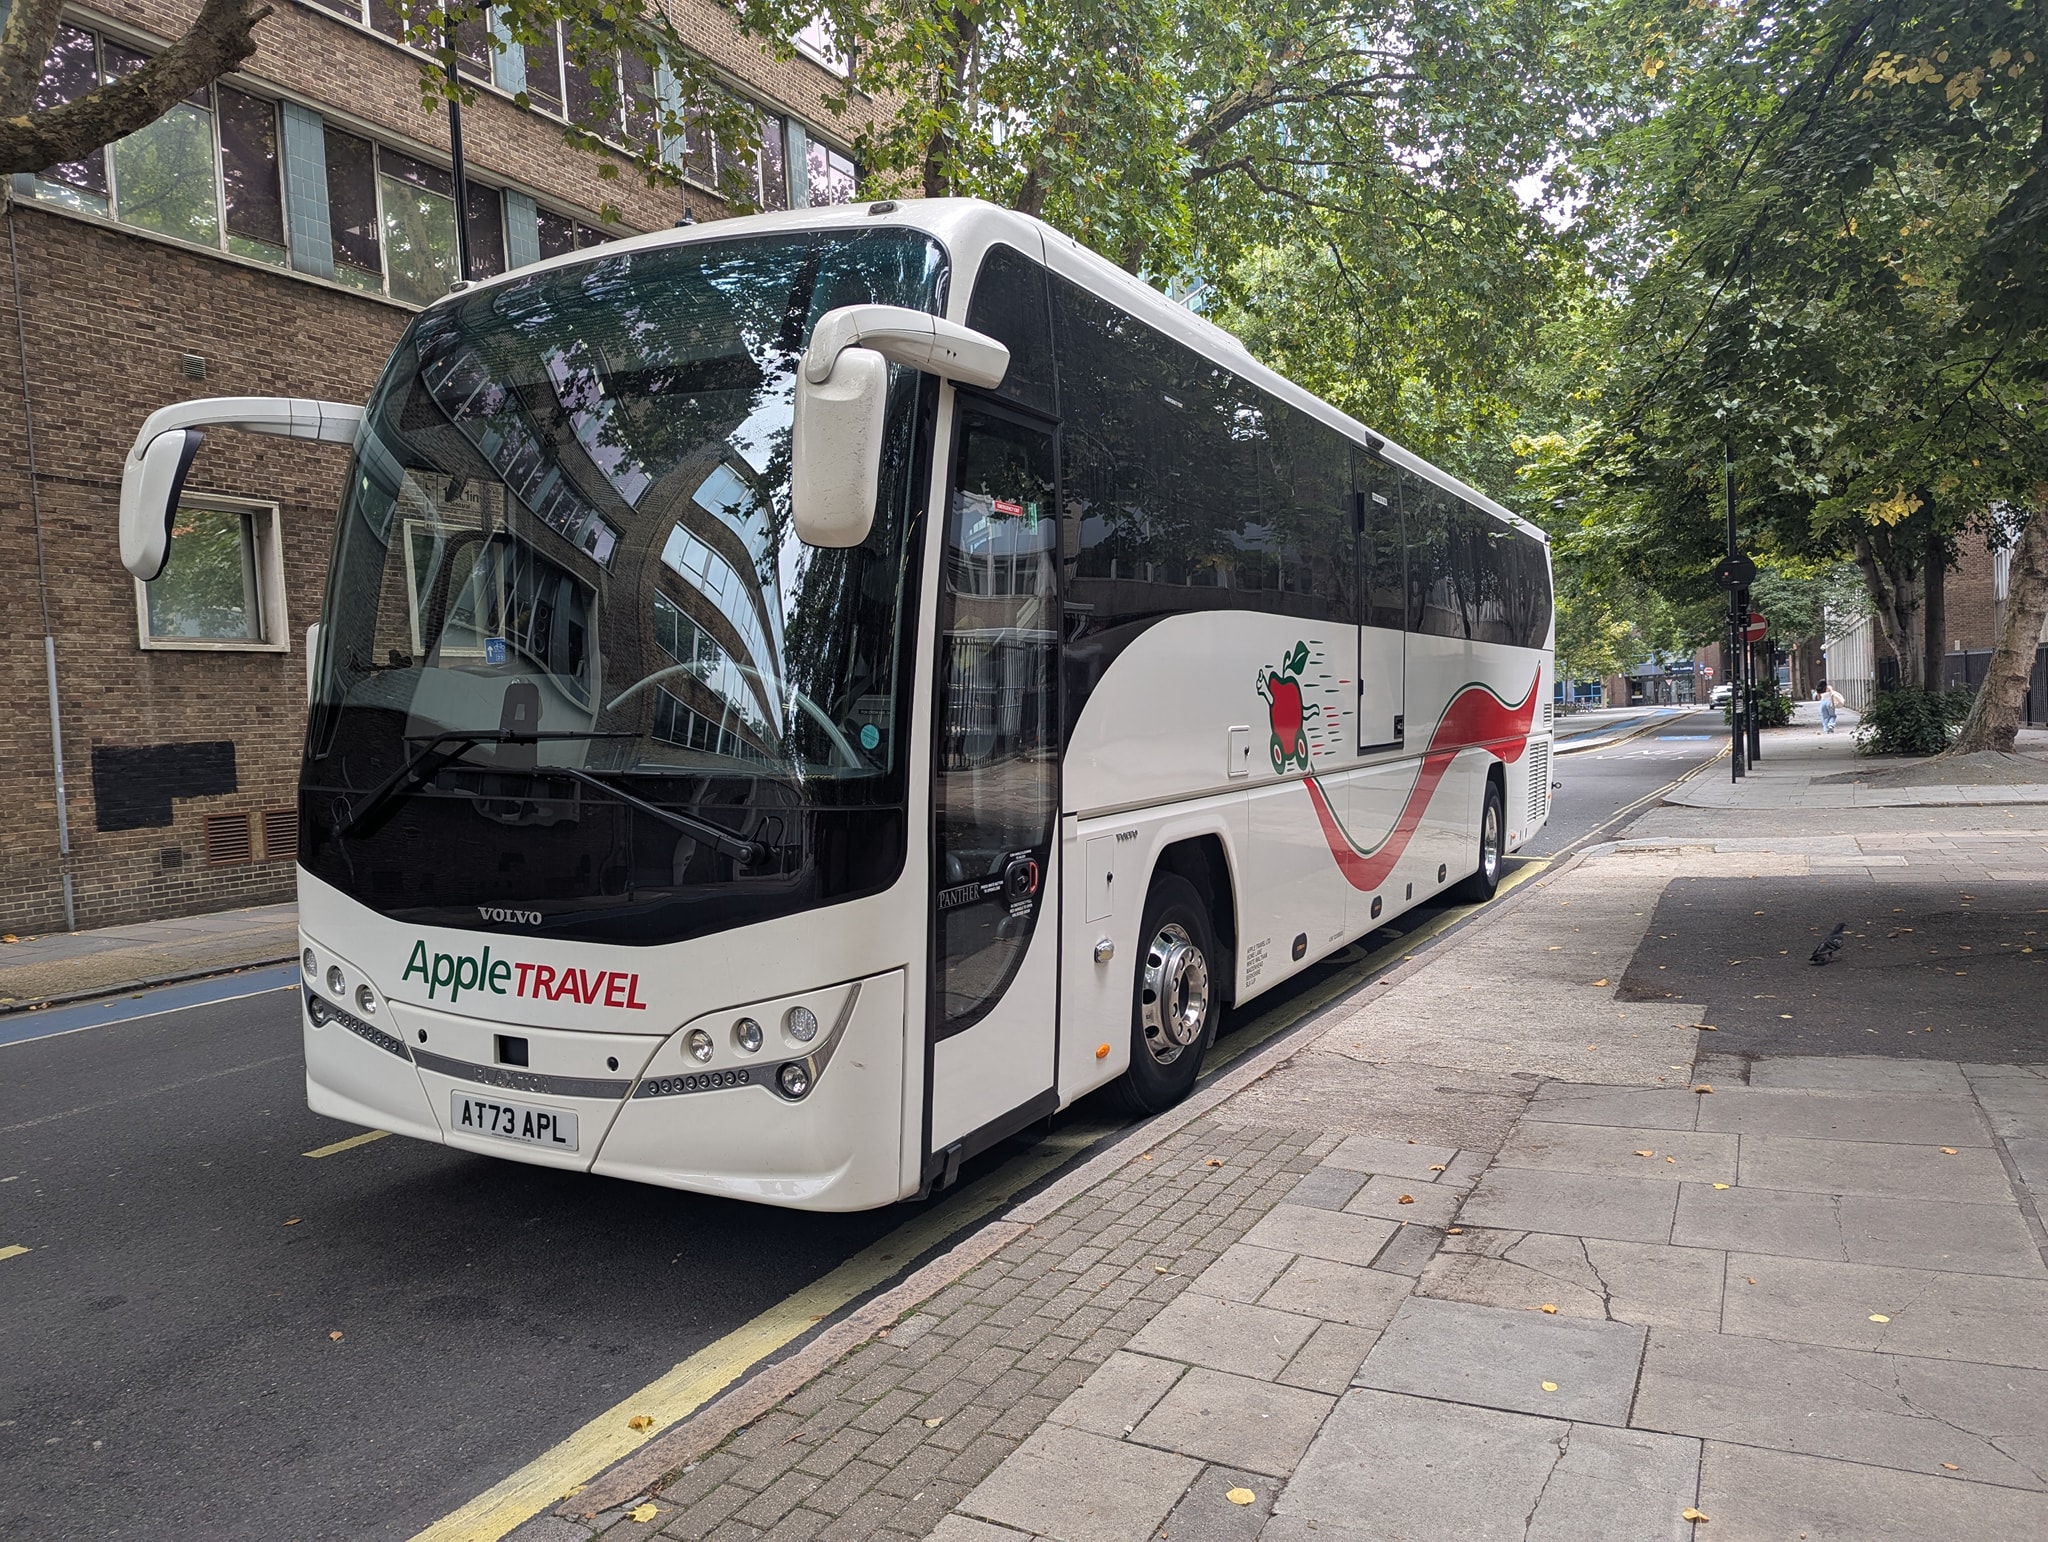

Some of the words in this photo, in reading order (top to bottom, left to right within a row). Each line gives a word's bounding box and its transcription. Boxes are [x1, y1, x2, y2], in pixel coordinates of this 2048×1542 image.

[939, 884, 980, 908] PANTHER
[477, 906, 542, 925] VOLVO
[461, 1099, 515, 1134] AT73
[522, 1110, 566, 1143] APL
